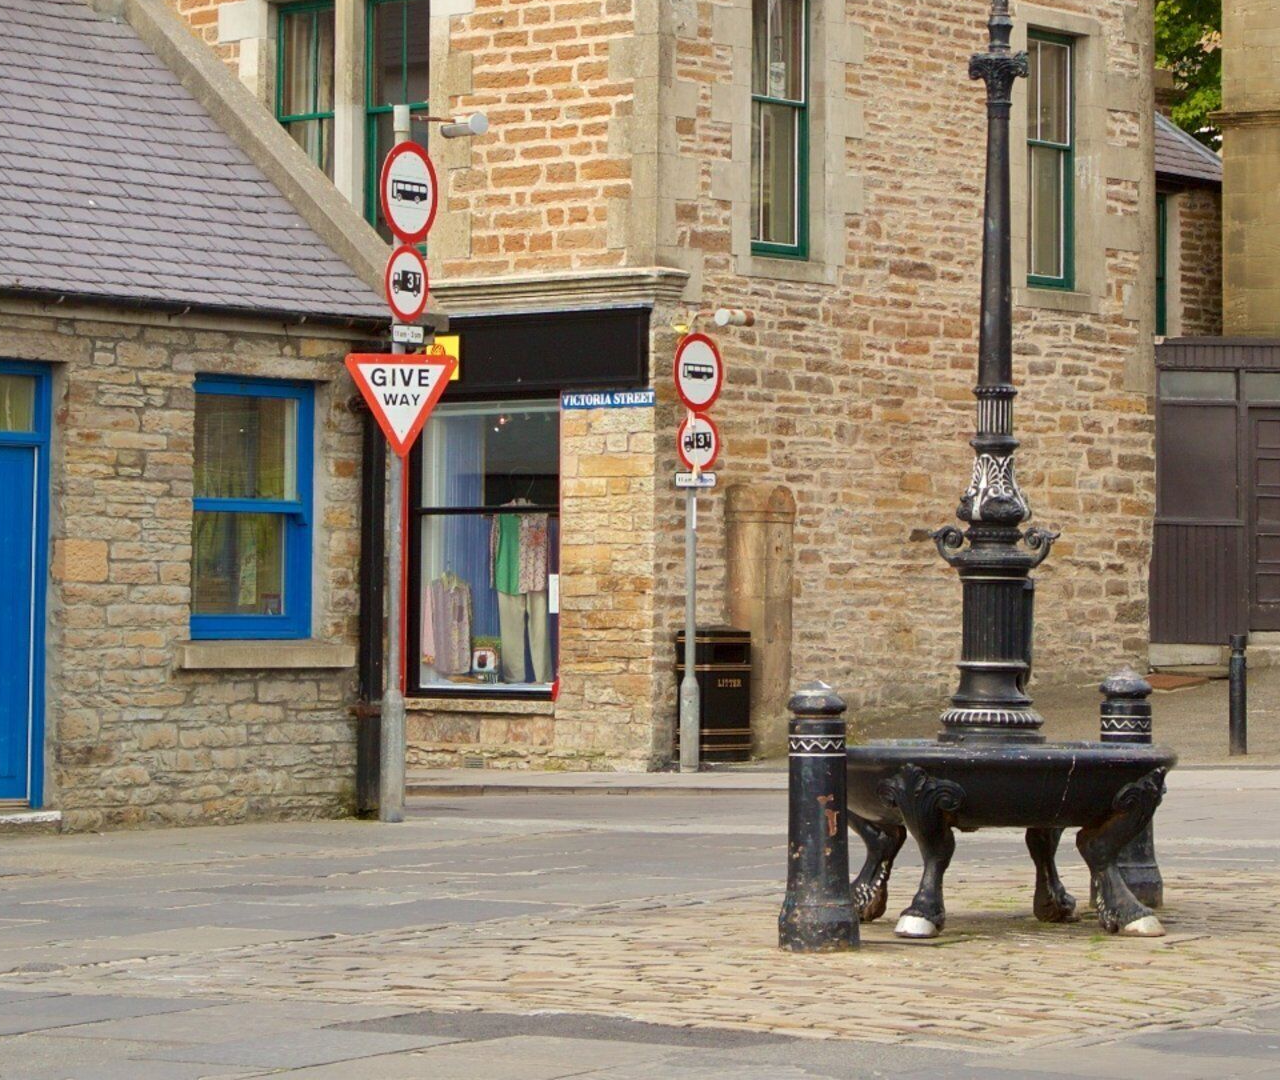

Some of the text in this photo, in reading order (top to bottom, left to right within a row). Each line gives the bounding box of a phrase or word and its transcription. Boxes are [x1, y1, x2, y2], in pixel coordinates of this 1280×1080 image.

[407, 272, 420, 289] 3T
[370, 367, 430, 387] GIVE
[383, 393, 421, 407] WAY
[562, 392, 654, 407] VICTORIA STREET
[717, 678, 742, 688] LITTER
